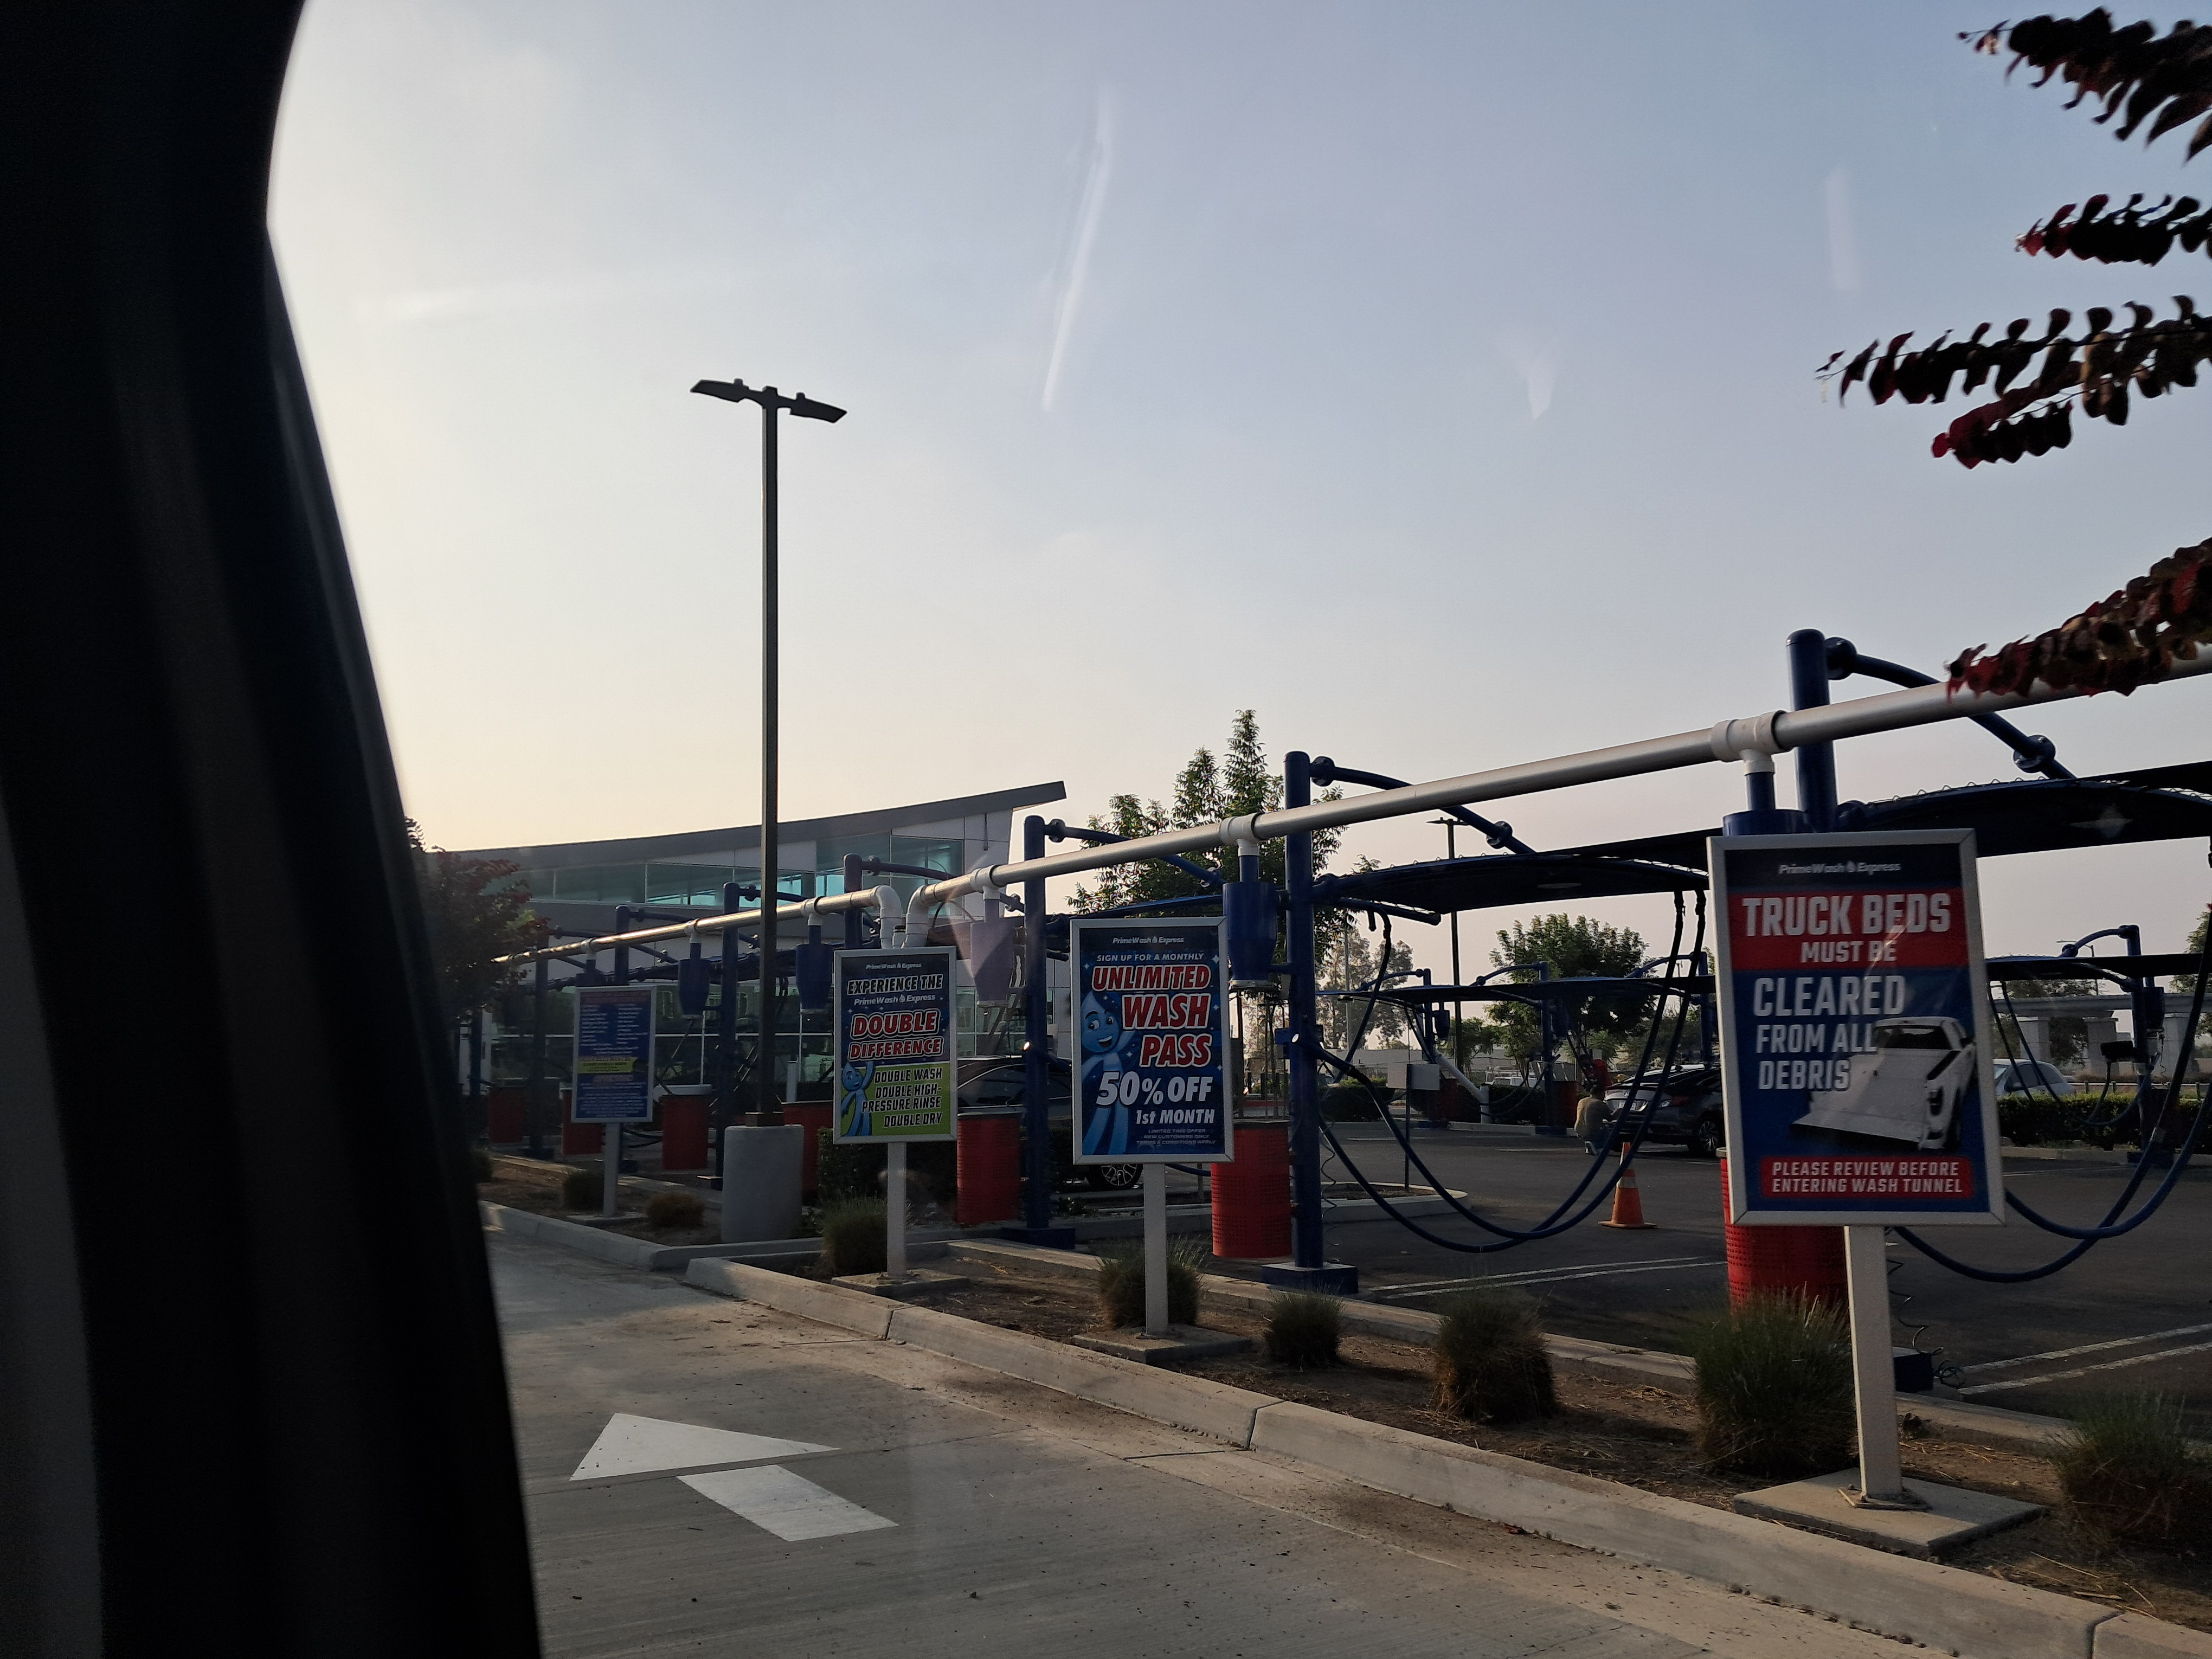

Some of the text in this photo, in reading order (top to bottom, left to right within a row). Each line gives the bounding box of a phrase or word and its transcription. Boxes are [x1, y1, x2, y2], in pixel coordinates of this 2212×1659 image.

[1778, 862, 1902, 876] PrimeWash Express
[1742, 892, 1952, 937] TRUCK BEDS
[1158, 936, 1184, 945] Express
[1162, 953, 1204, 961] MONTHLY
[1801, 940, 1898, 963] MUST BE
[847, 974, 943, 995] EXPERIENCE THE
[1091, 964, 1211, 992] UNLIMITED
[854, 994, 936, 1006] PrimeWash Express
[1753, 975, 1906, 1017] CLEARED
[1122, 993, 1211, 1030] WASH
[852, 1010, 939, 1038] DOUBLE
[1756, 1023, 1878, 1053] FROM ALL
[849, 1038, 943, 1060] DIFFERENCE
[1139, 1033, 1212, 1068] PASS
[874, 1068, 942, 1083] DOUBLE WASH
[1758, 1059, 1850, 1090] DEBRIS
[876, 1084, 942, 1098] DOUBLE HIGH-
[1096, 1071, 1213, 1106] 50% OFF
[862, 1096, 941, 1112] PRESSURE RINSE
[884, 1113, 942, 1127] DOUBLE DRY
[1136, 1109, 1216, 1124] 1st MONTH
[1772, 1161, 1959, 1176] PLEASE REVIEW BEFORE
[1772, 1178, 1963, 1193] ENTERING WASH TUNNEL
